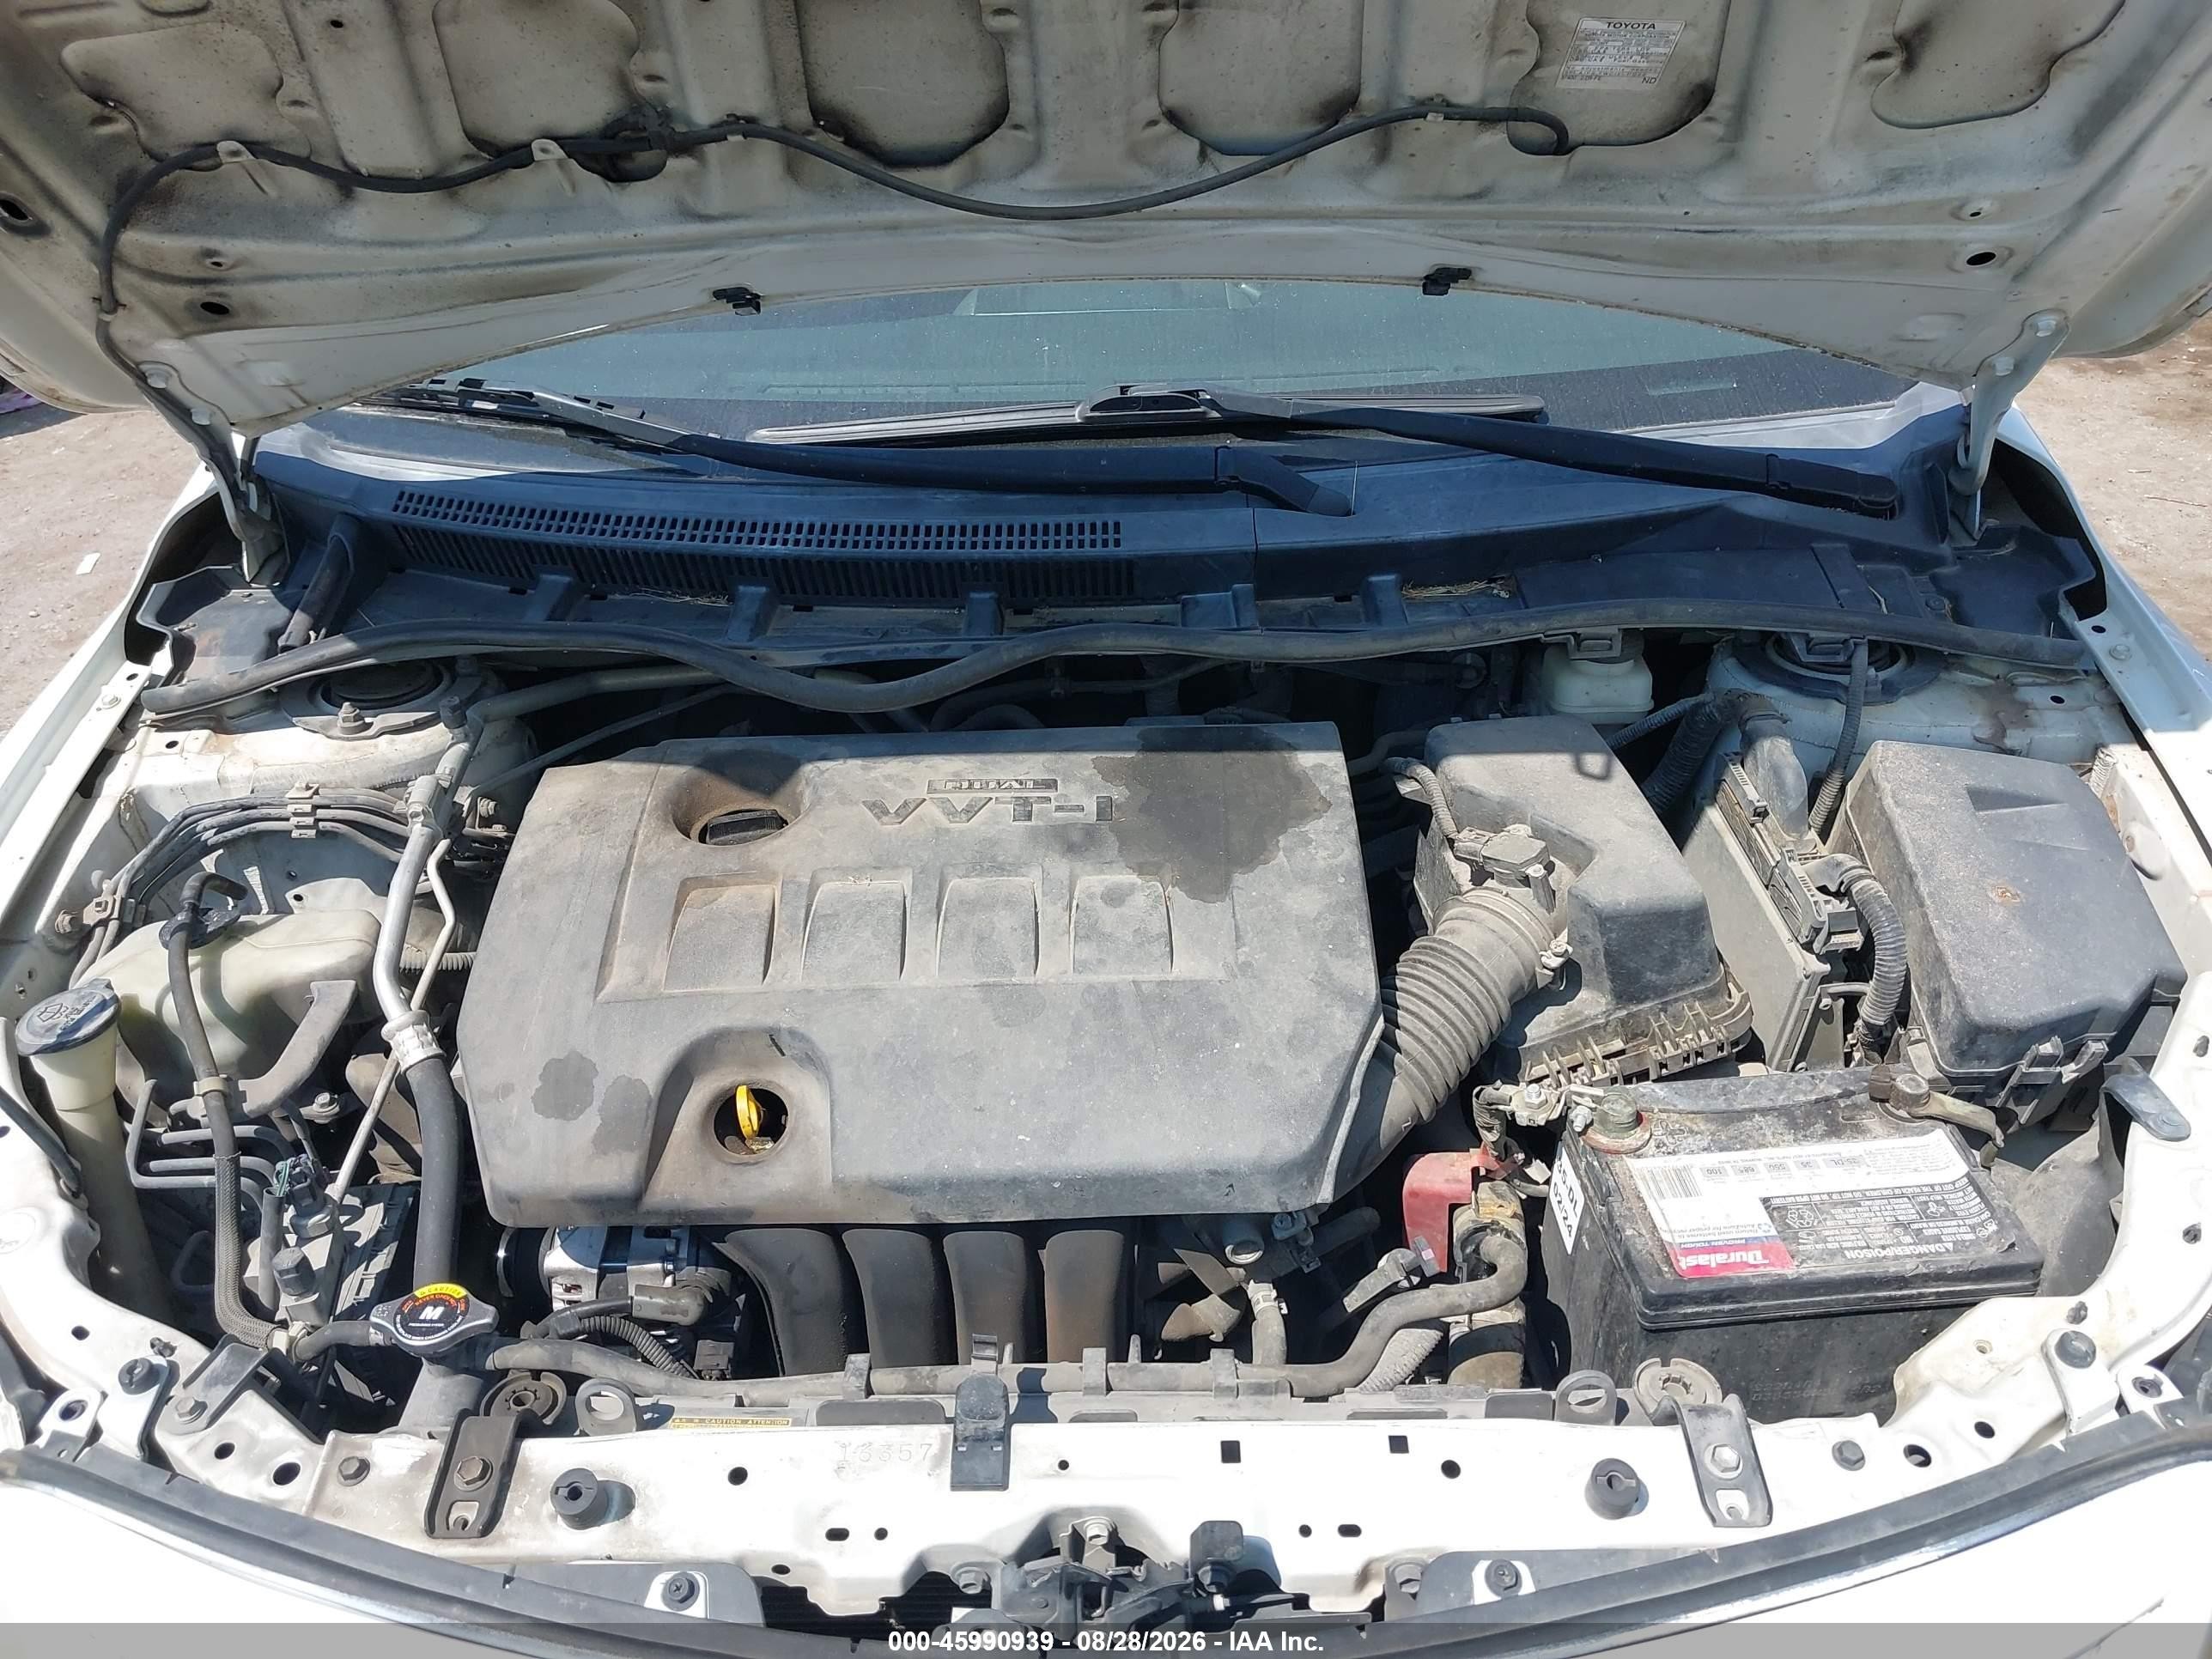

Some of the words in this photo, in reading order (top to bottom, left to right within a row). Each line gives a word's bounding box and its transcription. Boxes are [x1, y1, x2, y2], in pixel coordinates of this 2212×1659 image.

[1607, 21, 1656, 30] TOYOTA
[1641, 76, 1657, 85] ND
[944, 779, 1045, 789] DUAL
[1553, 1182, 1572, 1237] 02/24
[1844, 1243, 1943, 1260] DANGER/POISON
[1677, 1249, 1769, 1270] Duralast
[418, 1305, 445, 1320] M
